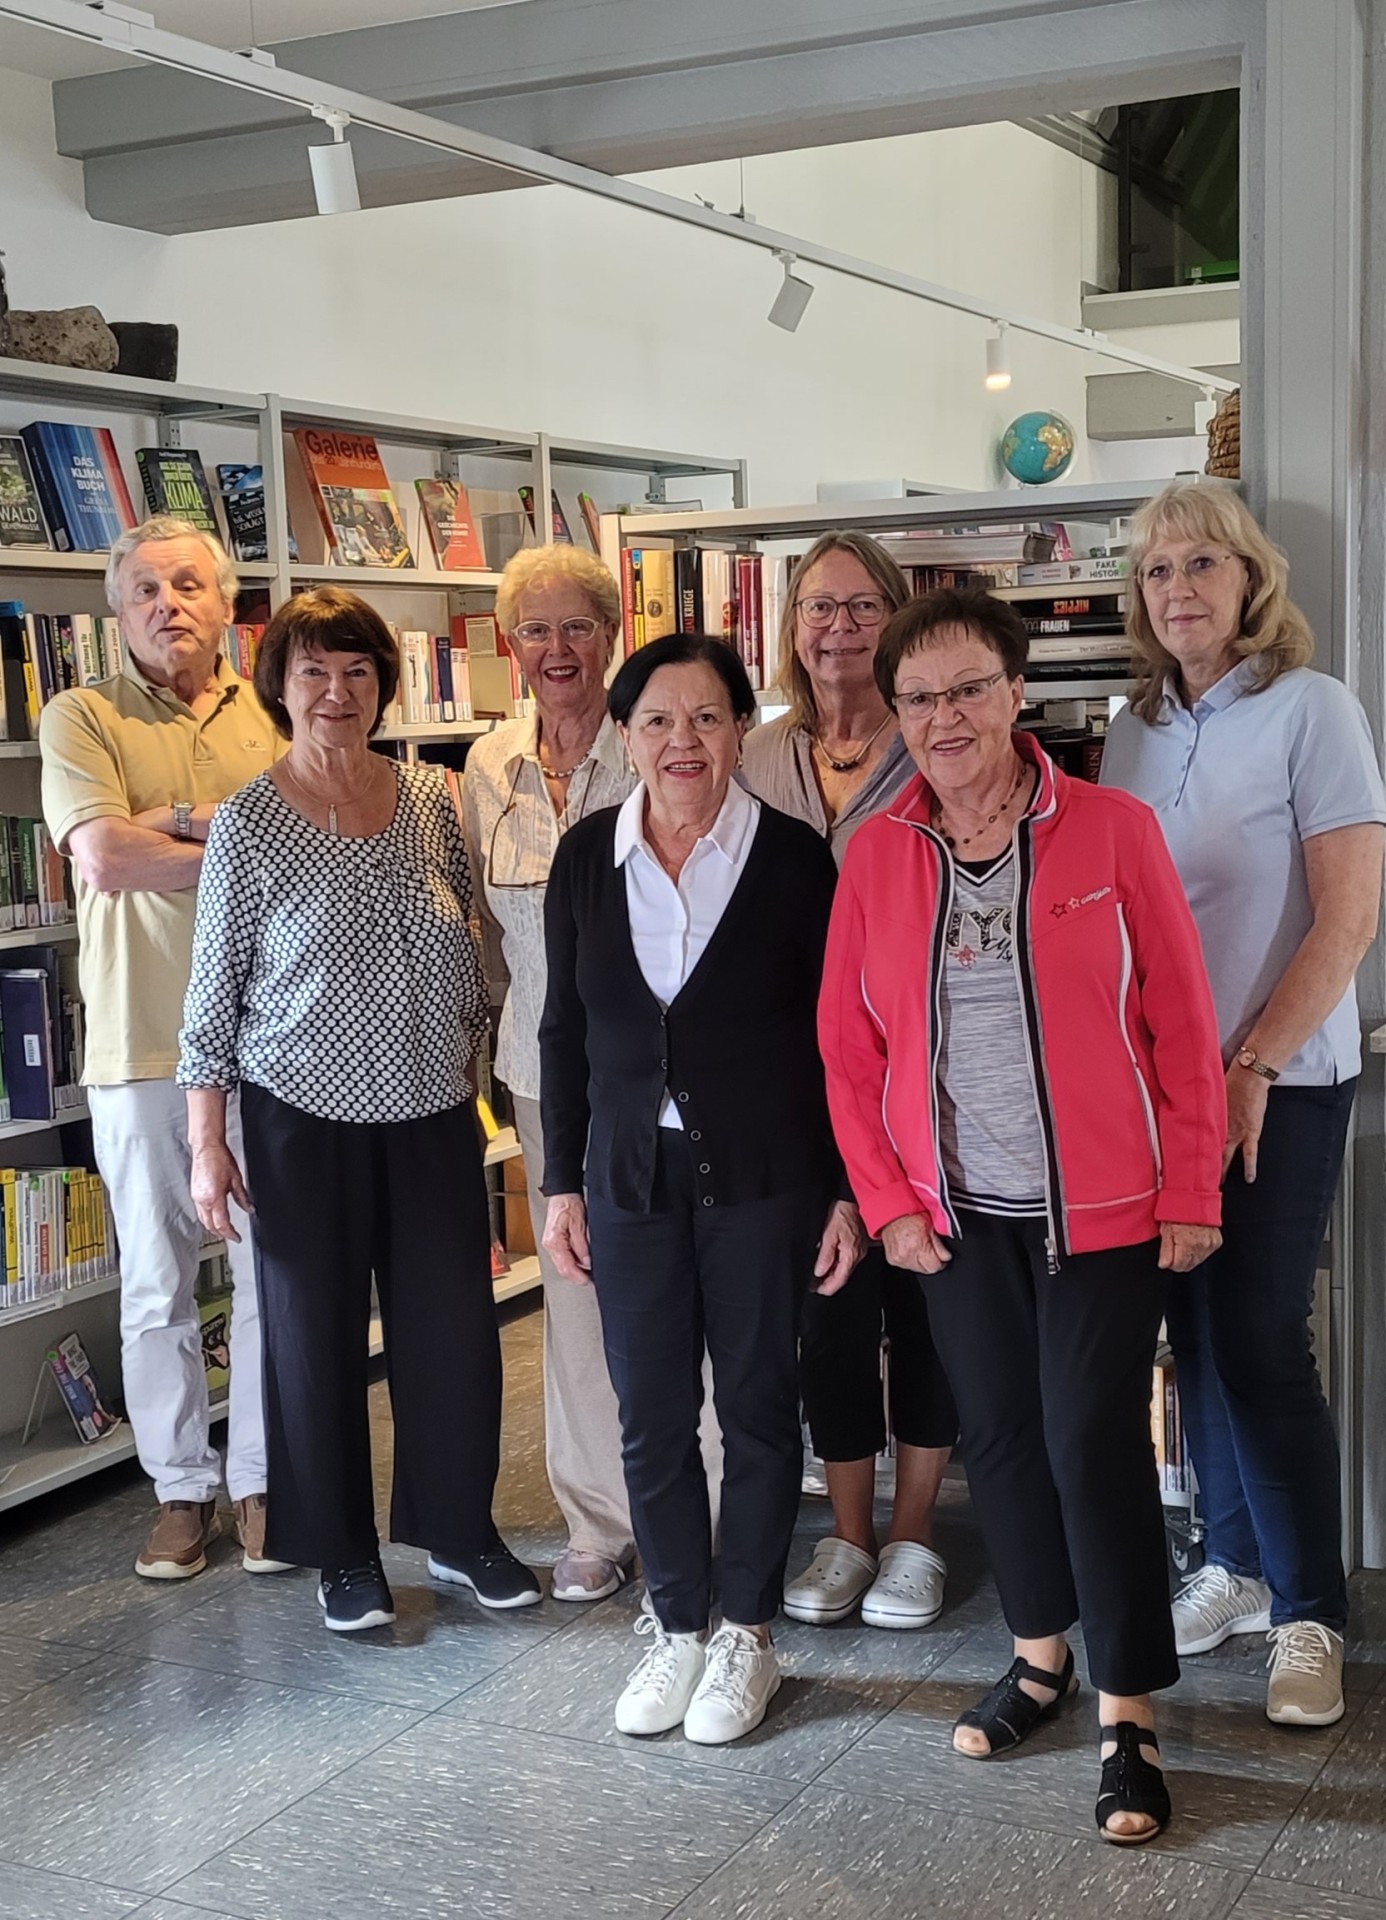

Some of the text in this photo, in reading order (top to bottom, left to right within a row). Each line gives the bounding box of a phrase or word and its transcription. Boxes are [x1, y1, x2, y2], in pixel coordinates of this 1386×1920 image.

[305, 430, 379, 461] Galerie
[73, 456, 94, 468] DAS
[71, 467, 104, 480] KLIMA
[76, 479, 106, 492] BUCH
[163, 482, 206, 510] KLIMA
[0, 506, 38, 523] WALD
[1095, 560, 1117, 569] FAKE
[1089, 569, 1120, 579] HISTOR
[1040, 619, 1070, 633] FRAUEN
